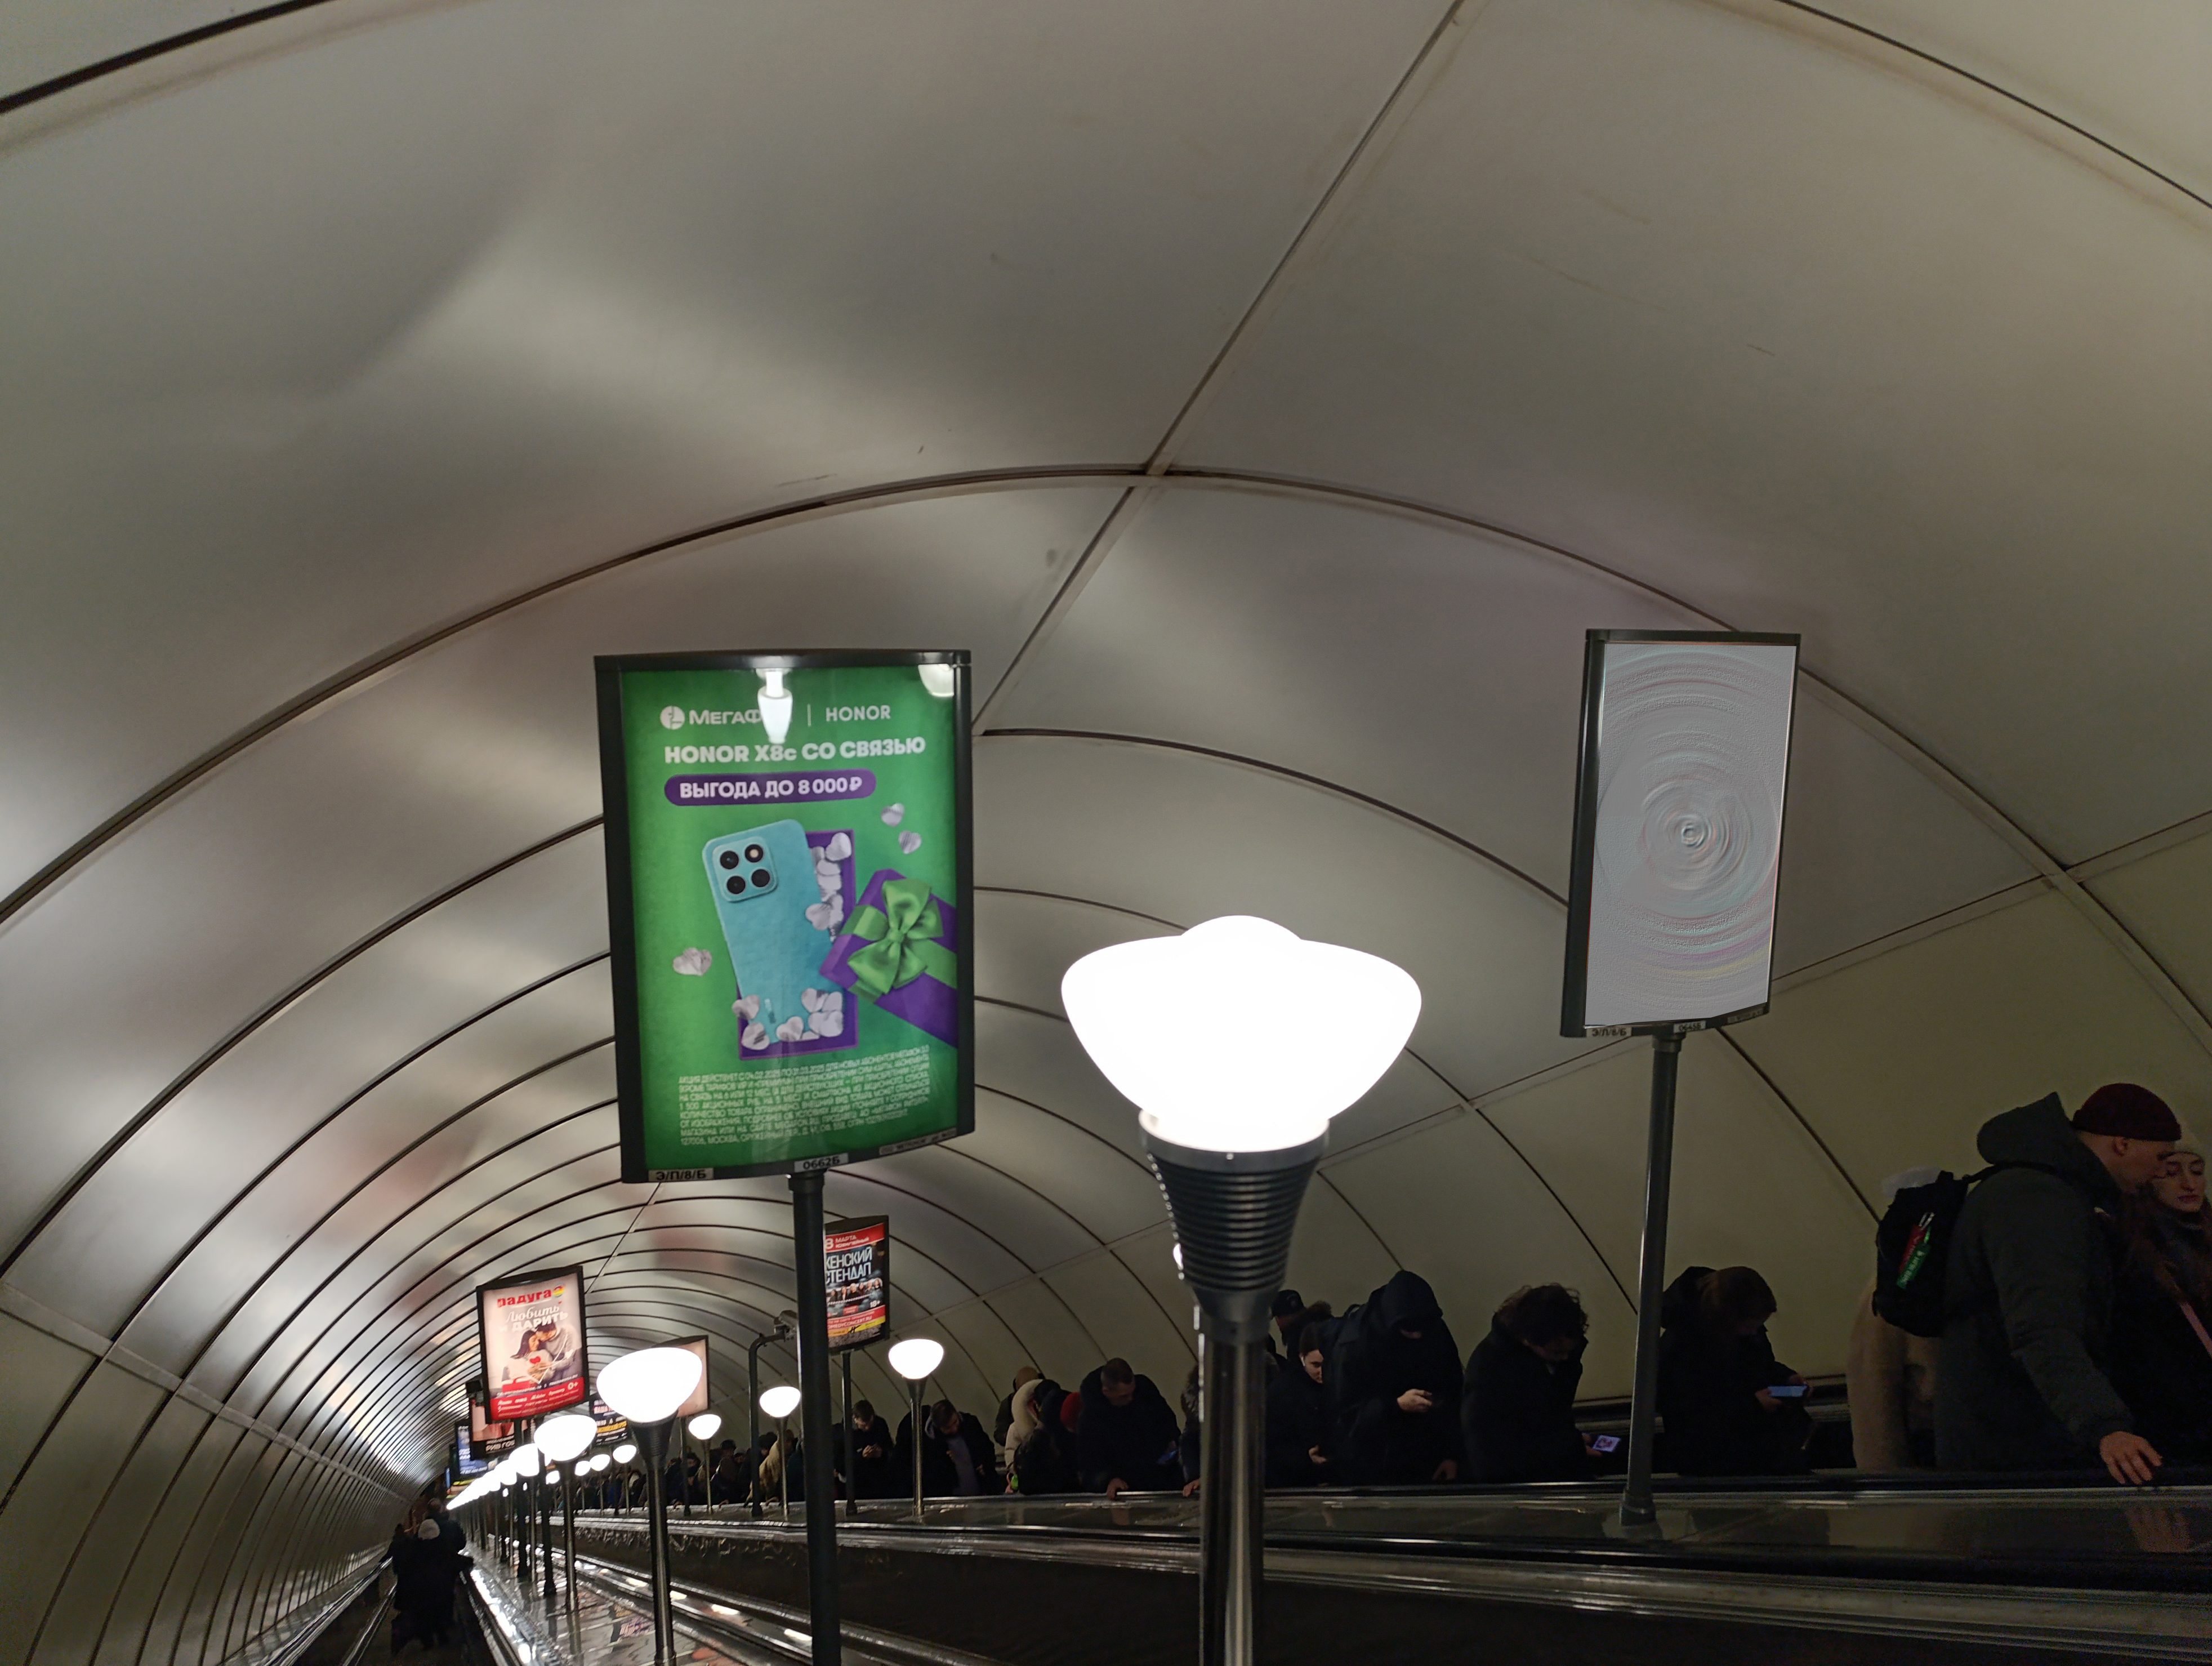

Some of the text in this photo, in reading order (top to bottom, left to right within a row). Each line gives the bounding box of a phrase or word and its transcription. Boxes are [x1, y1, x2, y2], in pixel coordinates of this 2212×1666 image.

[826, 705, 891, 721] HONOR
[665, 745, 750, 763] HONOR
[801, 742, 836, 760] СО
[840, 737, 926, 759] СВЯЗЬЮ
[680, 781, 761, 799] ВЫГОДА
[765, 780, 794, 798] ДО
[497, 1289, 551, 1307] радуга
[506, 1306, 560, 1322] Любить
[512, 1312, 568, 1331] ДАРИТЬ
